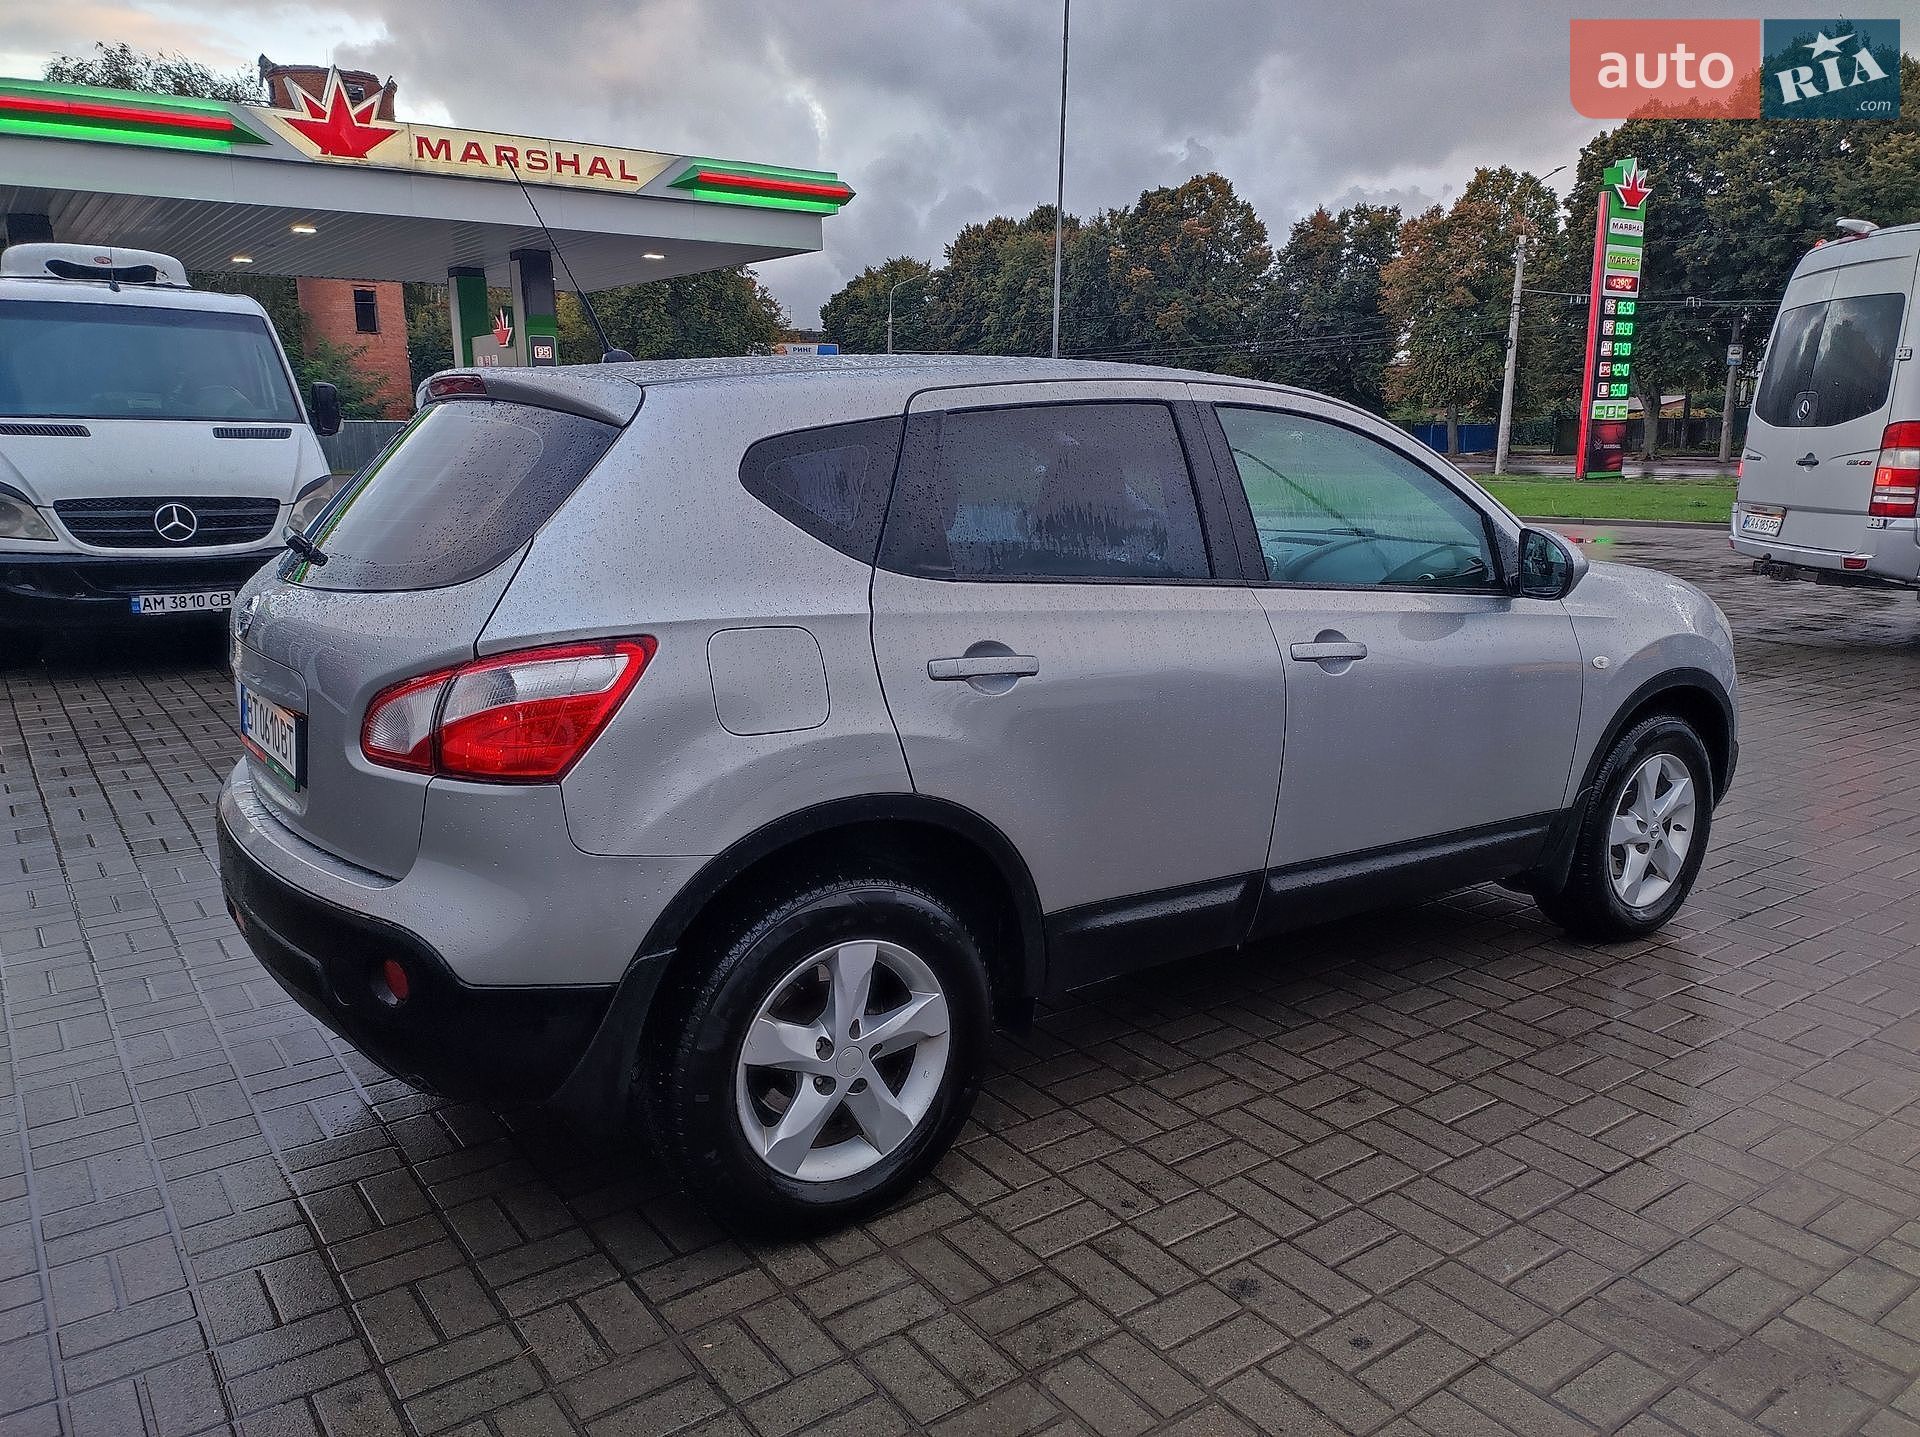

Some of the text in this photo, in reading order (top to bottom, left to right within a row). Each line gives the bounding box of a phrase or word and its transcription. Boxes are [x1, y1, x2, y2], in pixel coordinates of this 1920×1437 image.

[415, 135, 639, 182] MARSHAL
[1612, 222, 1643, 233] MARSHAL
[1608, 254, 1640, 266] MARKET
[537, 347, 550, 355] 95
[143, 592, 232, 611] AM 3810 CB
